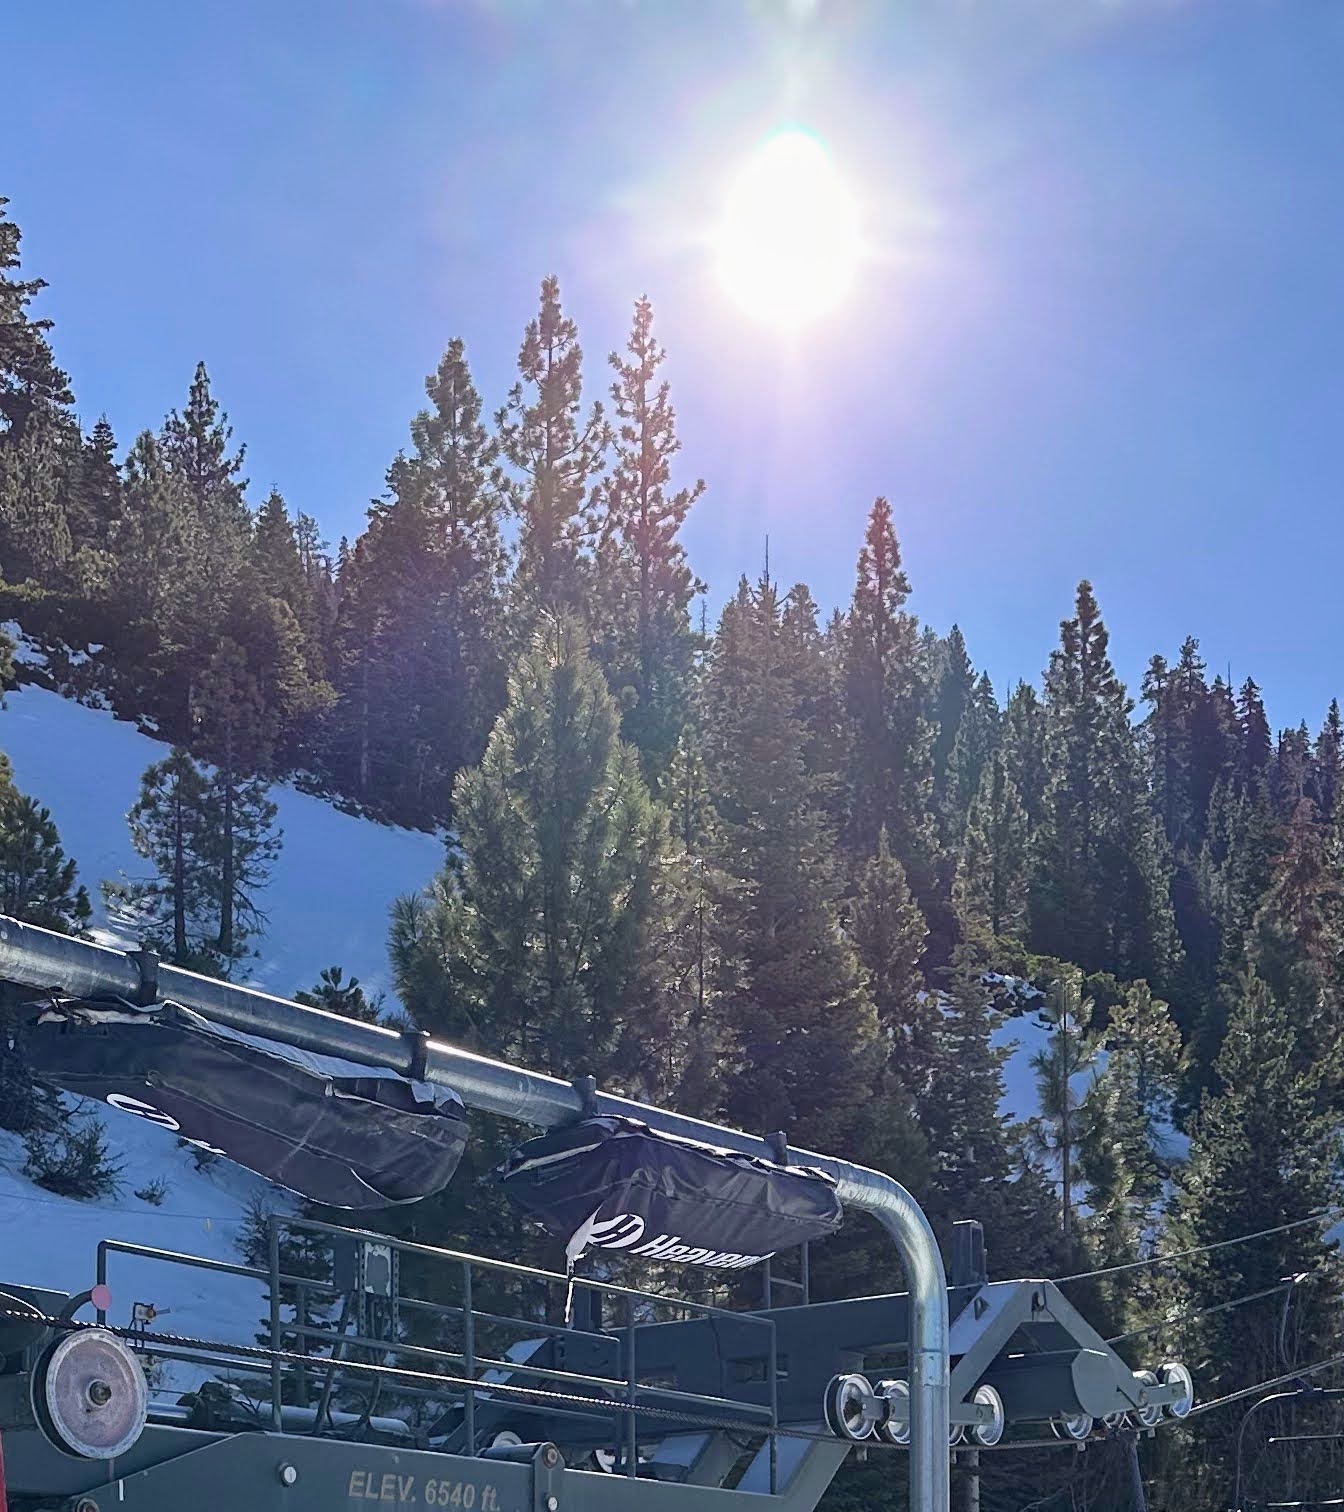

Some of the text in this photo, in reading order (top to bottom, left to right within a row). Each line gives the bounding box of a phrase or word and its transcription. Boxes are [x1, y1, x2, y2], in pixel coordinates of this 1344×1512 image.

[348, 1471, 501, 1512] ELEV. 6540 ft.
